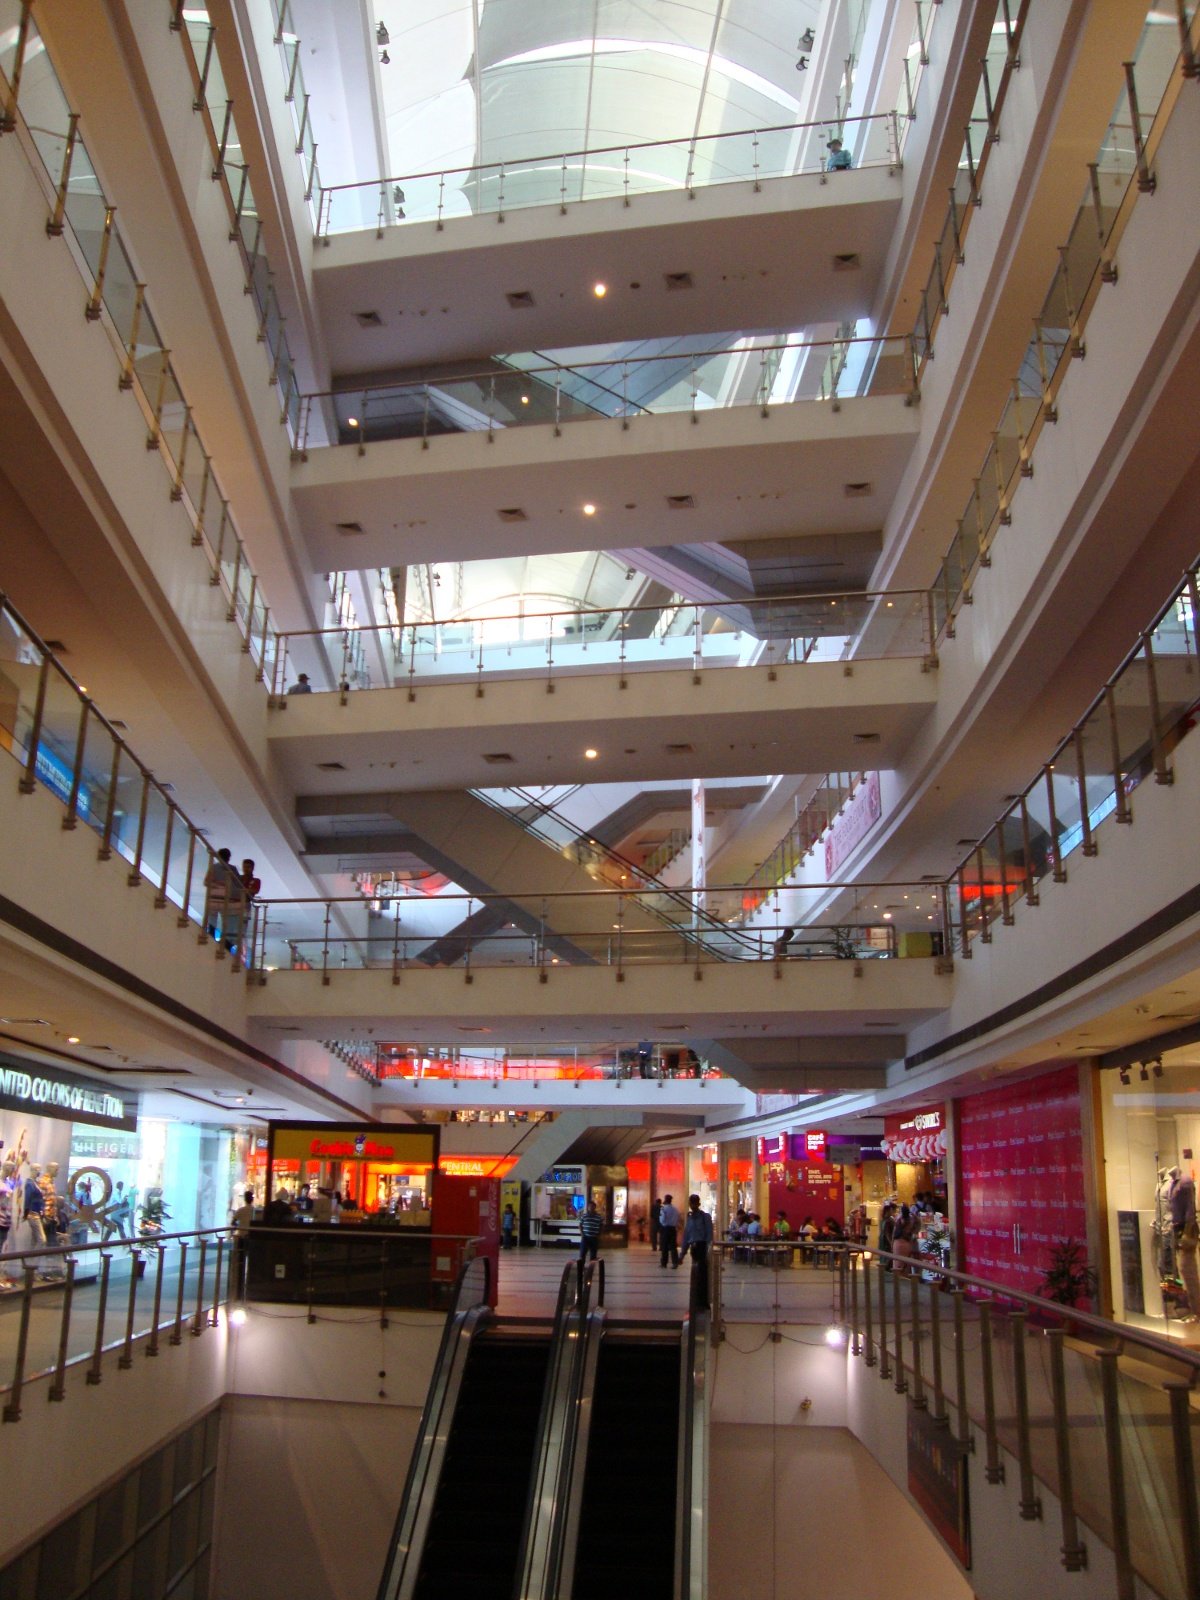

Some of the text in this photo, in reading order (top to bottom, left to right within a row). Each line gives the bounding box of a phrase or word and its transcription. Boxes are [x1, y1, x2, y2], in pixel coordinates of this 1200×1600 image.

[0, 1068, 32, 1098] NITED
[32, 1077, 71, 1107] COLORS
[71, 1087, 84, 1110] OF
